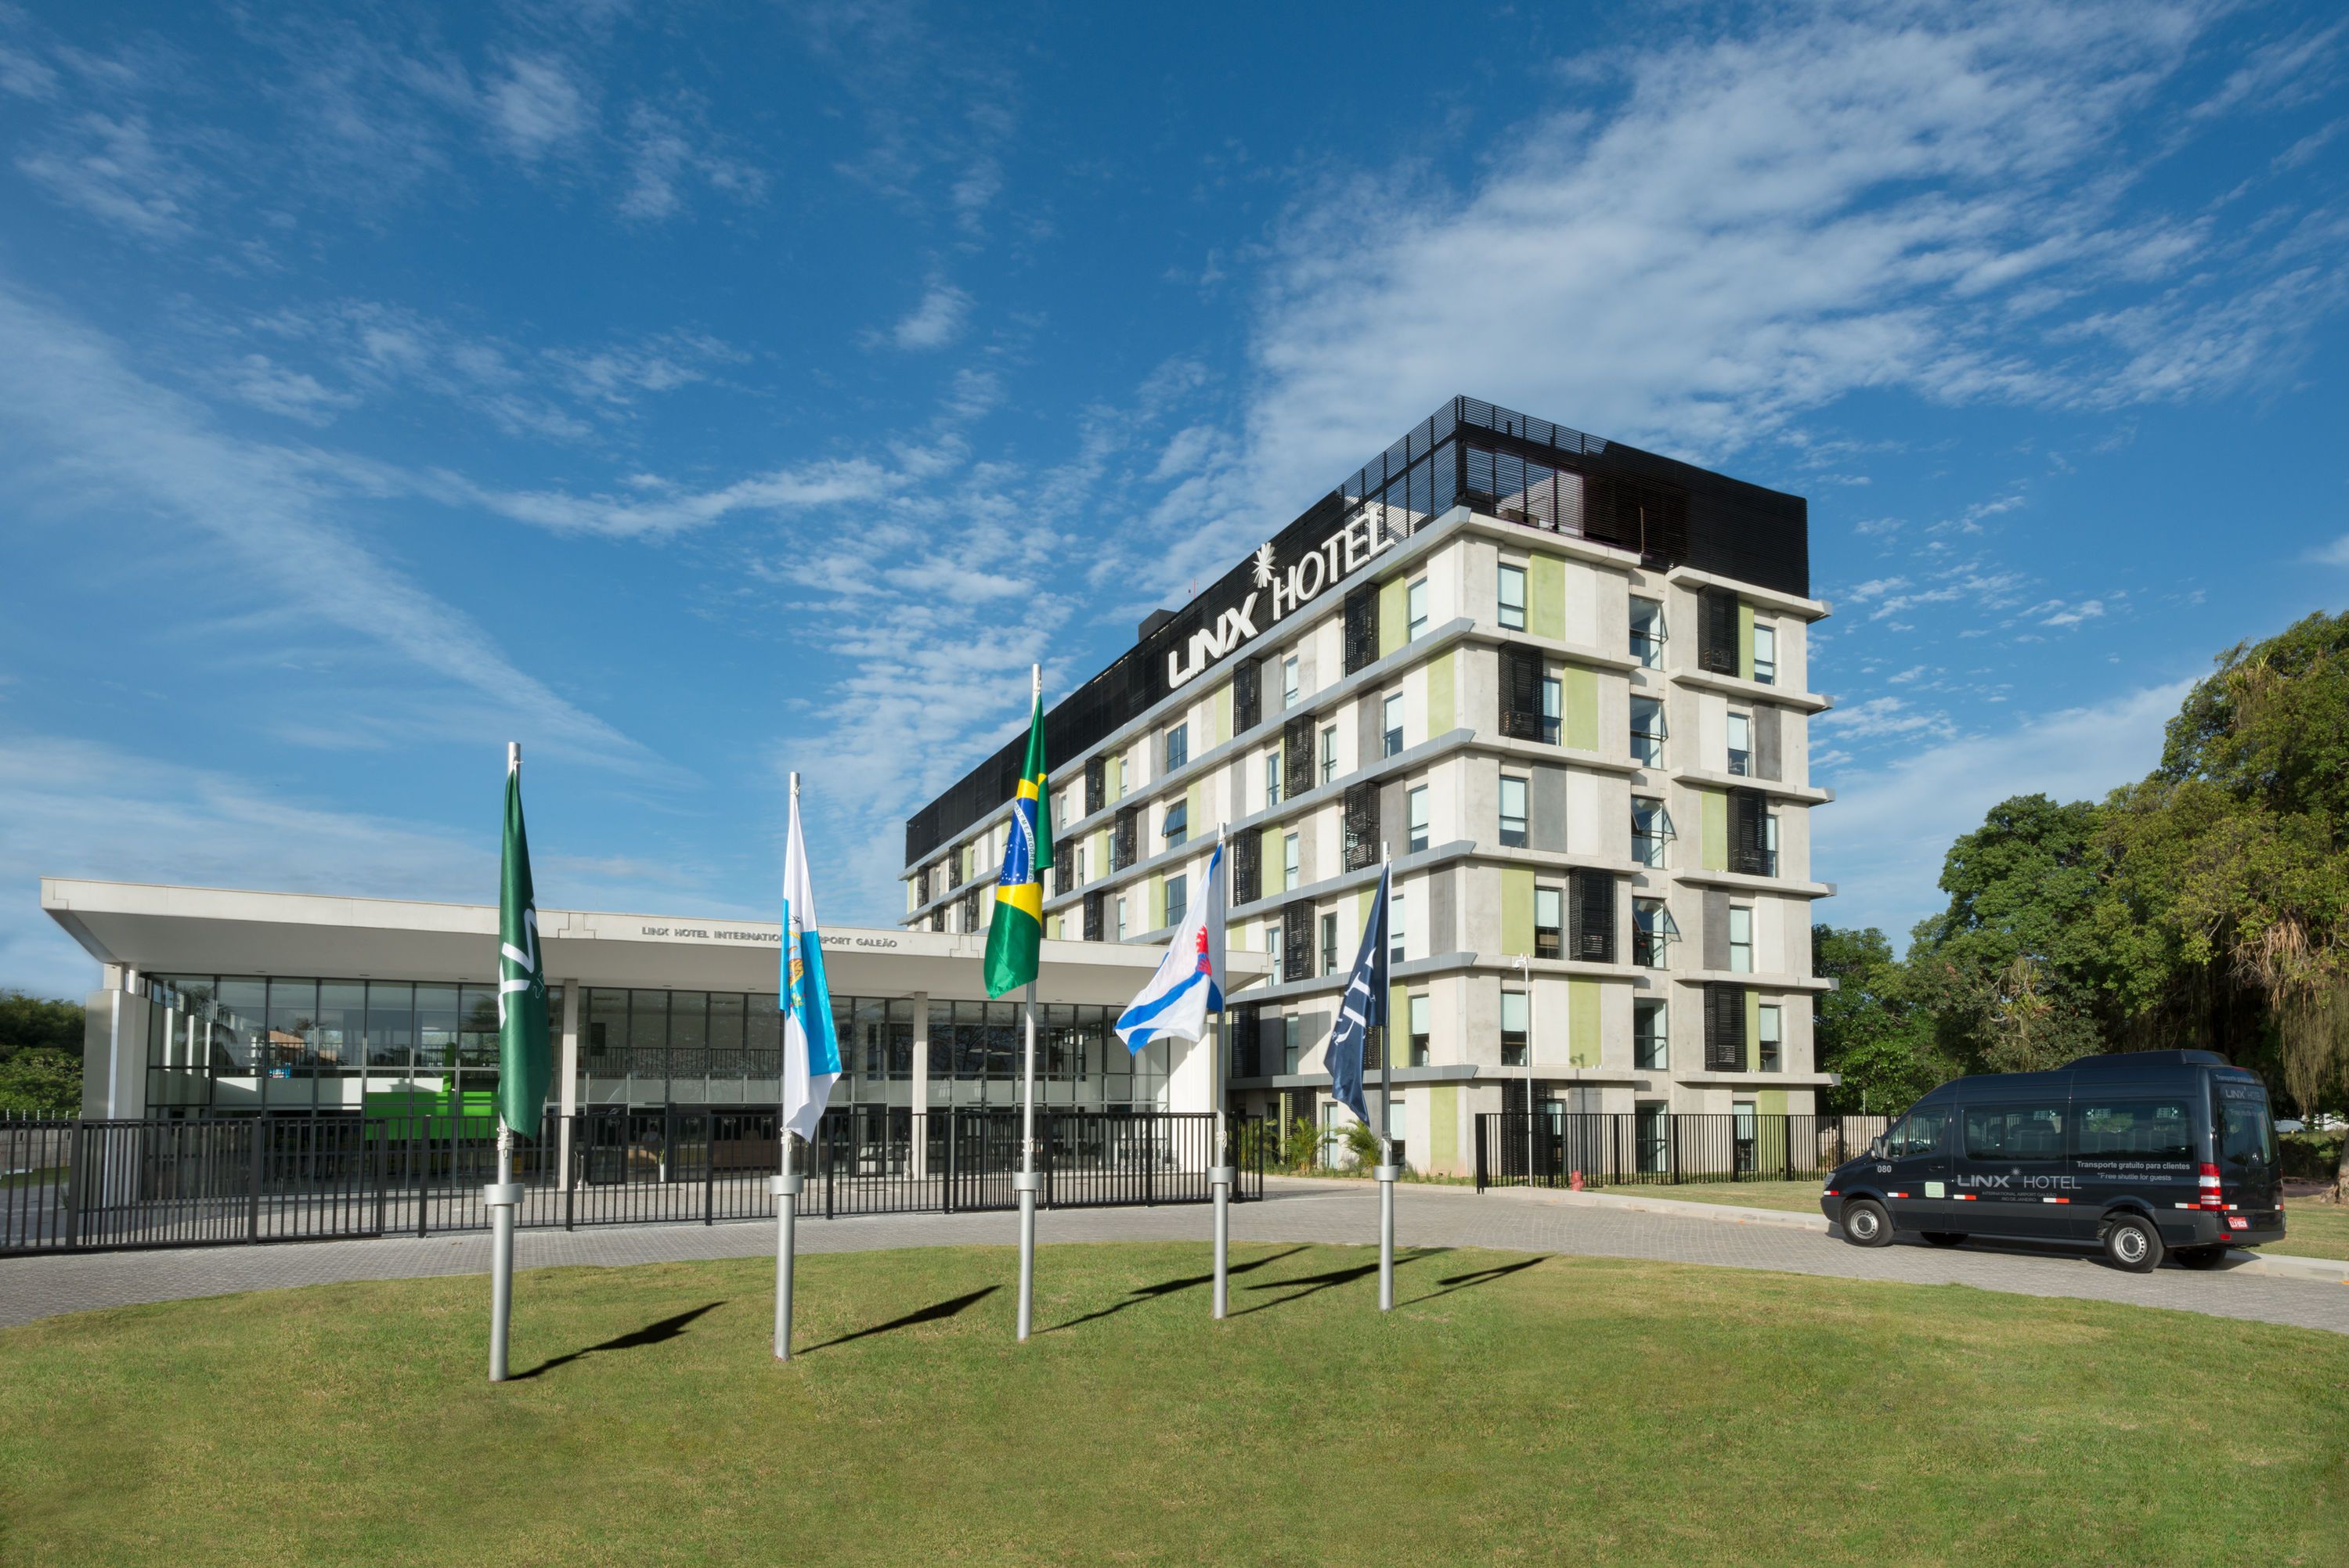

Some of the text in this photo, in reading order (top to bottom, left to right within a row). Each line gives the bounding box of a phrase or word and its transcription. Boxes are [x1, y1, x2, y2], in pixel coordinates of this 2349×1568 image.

[1168, 506, 1397, 688] LINX HOTEL
[641, 926, 669, 936] LINX
[673, 928, 709, 939] HOTEL
[713, 930, 782, 942] INTERNATIO
[856, 937, 897, 948] GALEÃO
[2225, 1089, 2245, 1099] LINX
[2077, 1160, 2117, 1170] Transporte
[1958, 1175, 2082, 1189] LINX HOTEL
